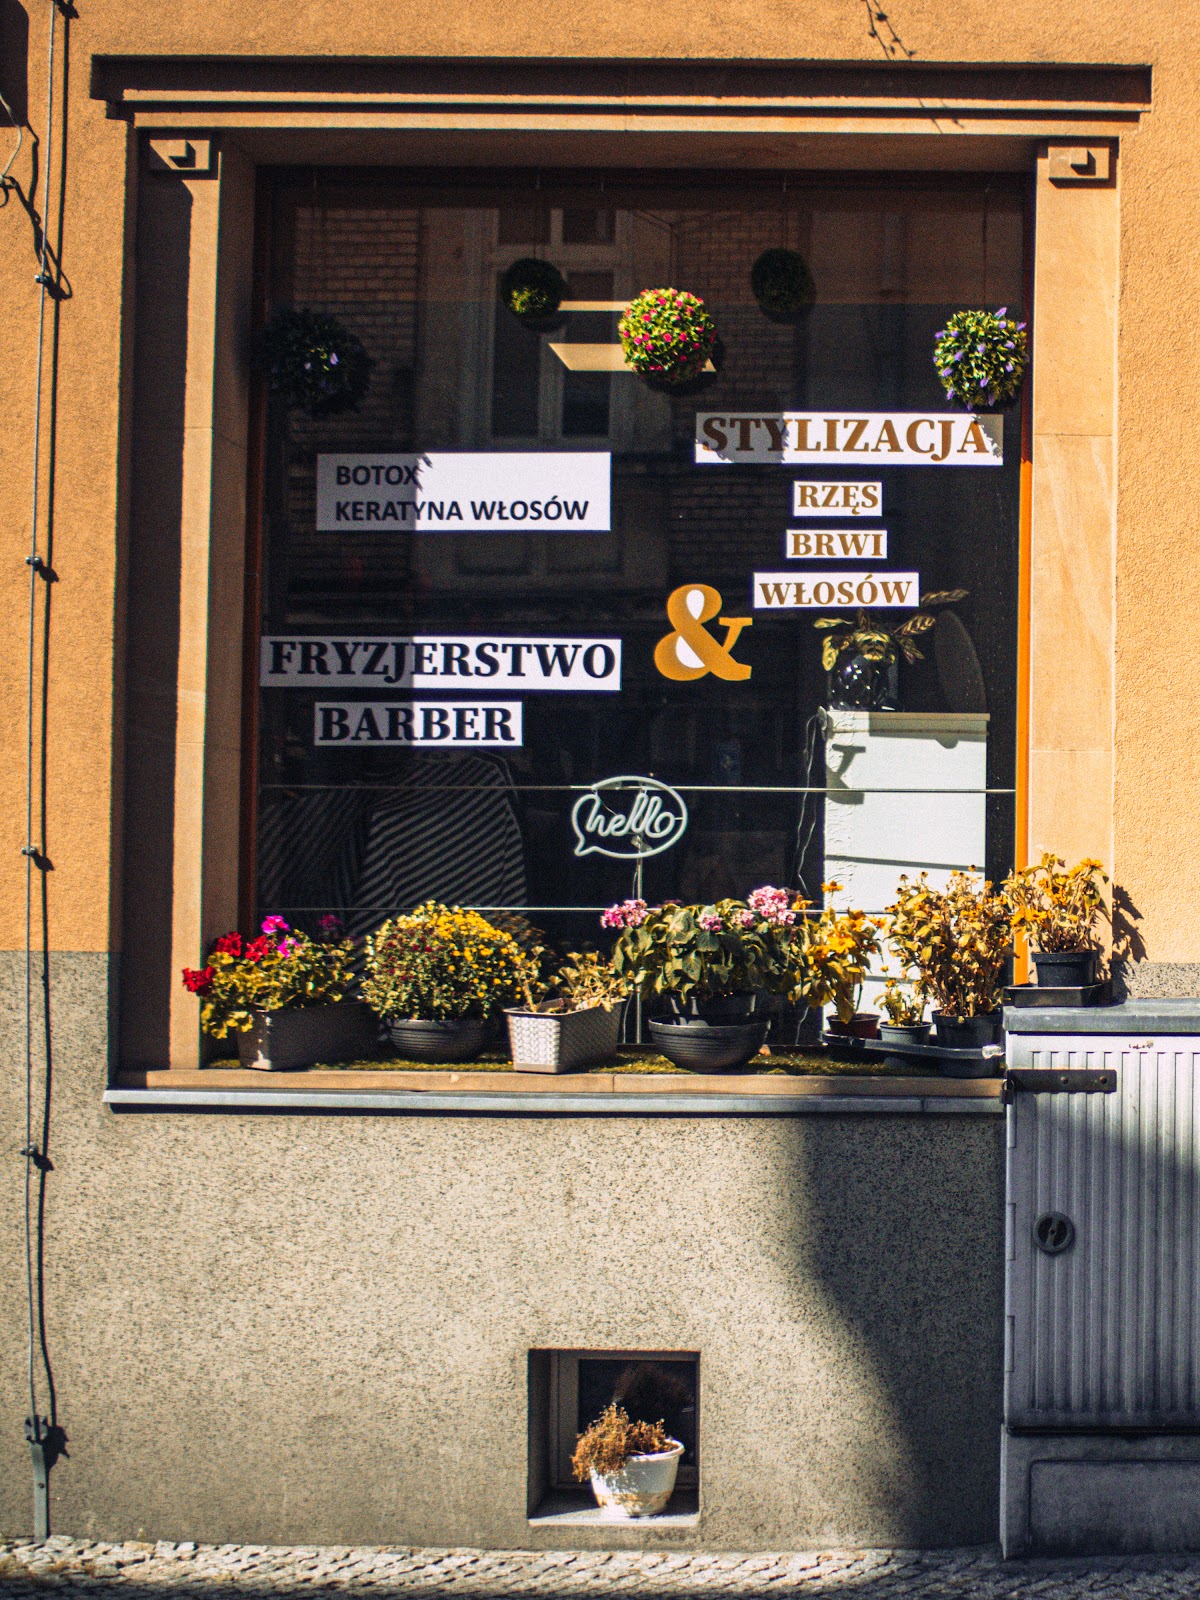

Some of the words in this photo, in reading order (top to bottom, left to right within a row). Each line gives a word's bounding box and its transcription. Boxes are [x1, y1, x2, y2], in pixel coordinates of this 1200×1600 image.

[701, 416, 991, 462] STYLIZACJA
[335, 465, 420, 486] BOTOX
[335, 500, 464, 522] KERATYNA
[471, 494, 590, 522] WŁOSÓW
[797, 483, 880, 515] RZĘS
[791, 533, 884, 557] BRWI
[759, 574, 914, 606] WŁOSÓW
[654, 583, 754, 682] &
[268, 640, 616, 683] FRYZJERSTWO
[318, 705, 514, 742] BARBER
[583, 791, 676, 838] hello
